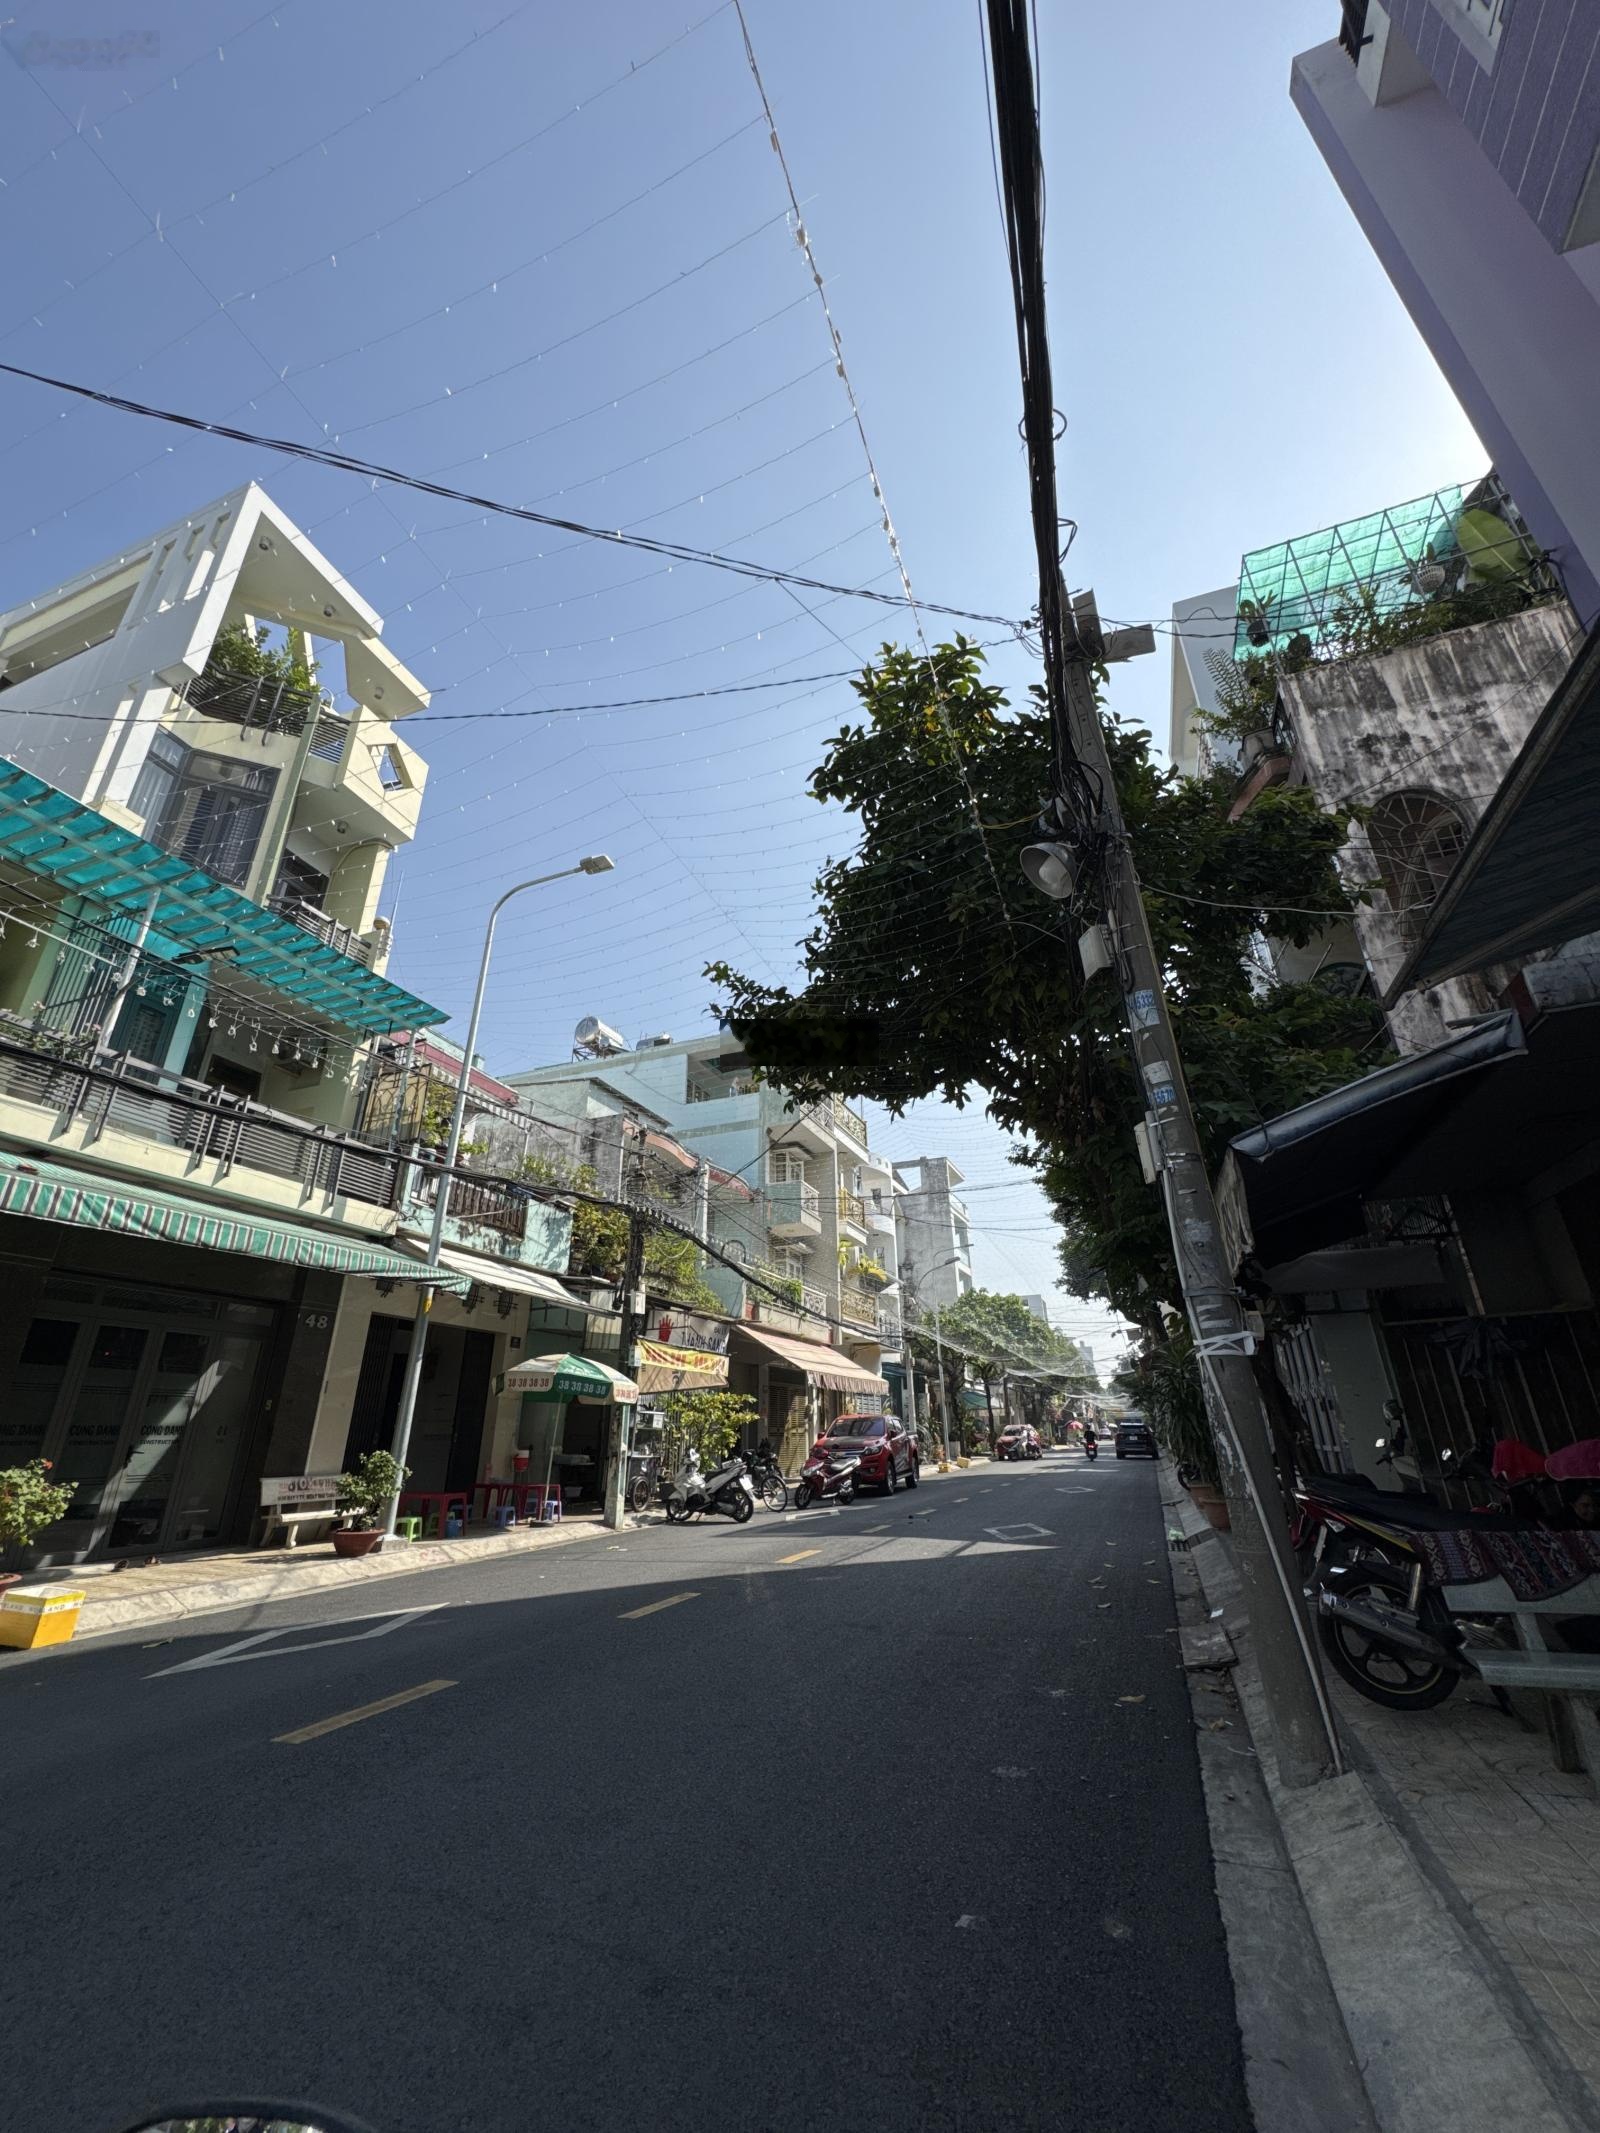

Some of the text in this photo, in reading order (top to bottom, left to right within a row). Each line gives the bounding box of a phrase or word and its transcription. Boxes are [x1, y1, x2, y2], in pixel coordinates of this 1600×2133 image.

[305, 1314, 328, 1329] 48
[508, 1377, 549, 1388] 38 38 38 38
[558, 1380, 607, 1395] 38 38 38 38
